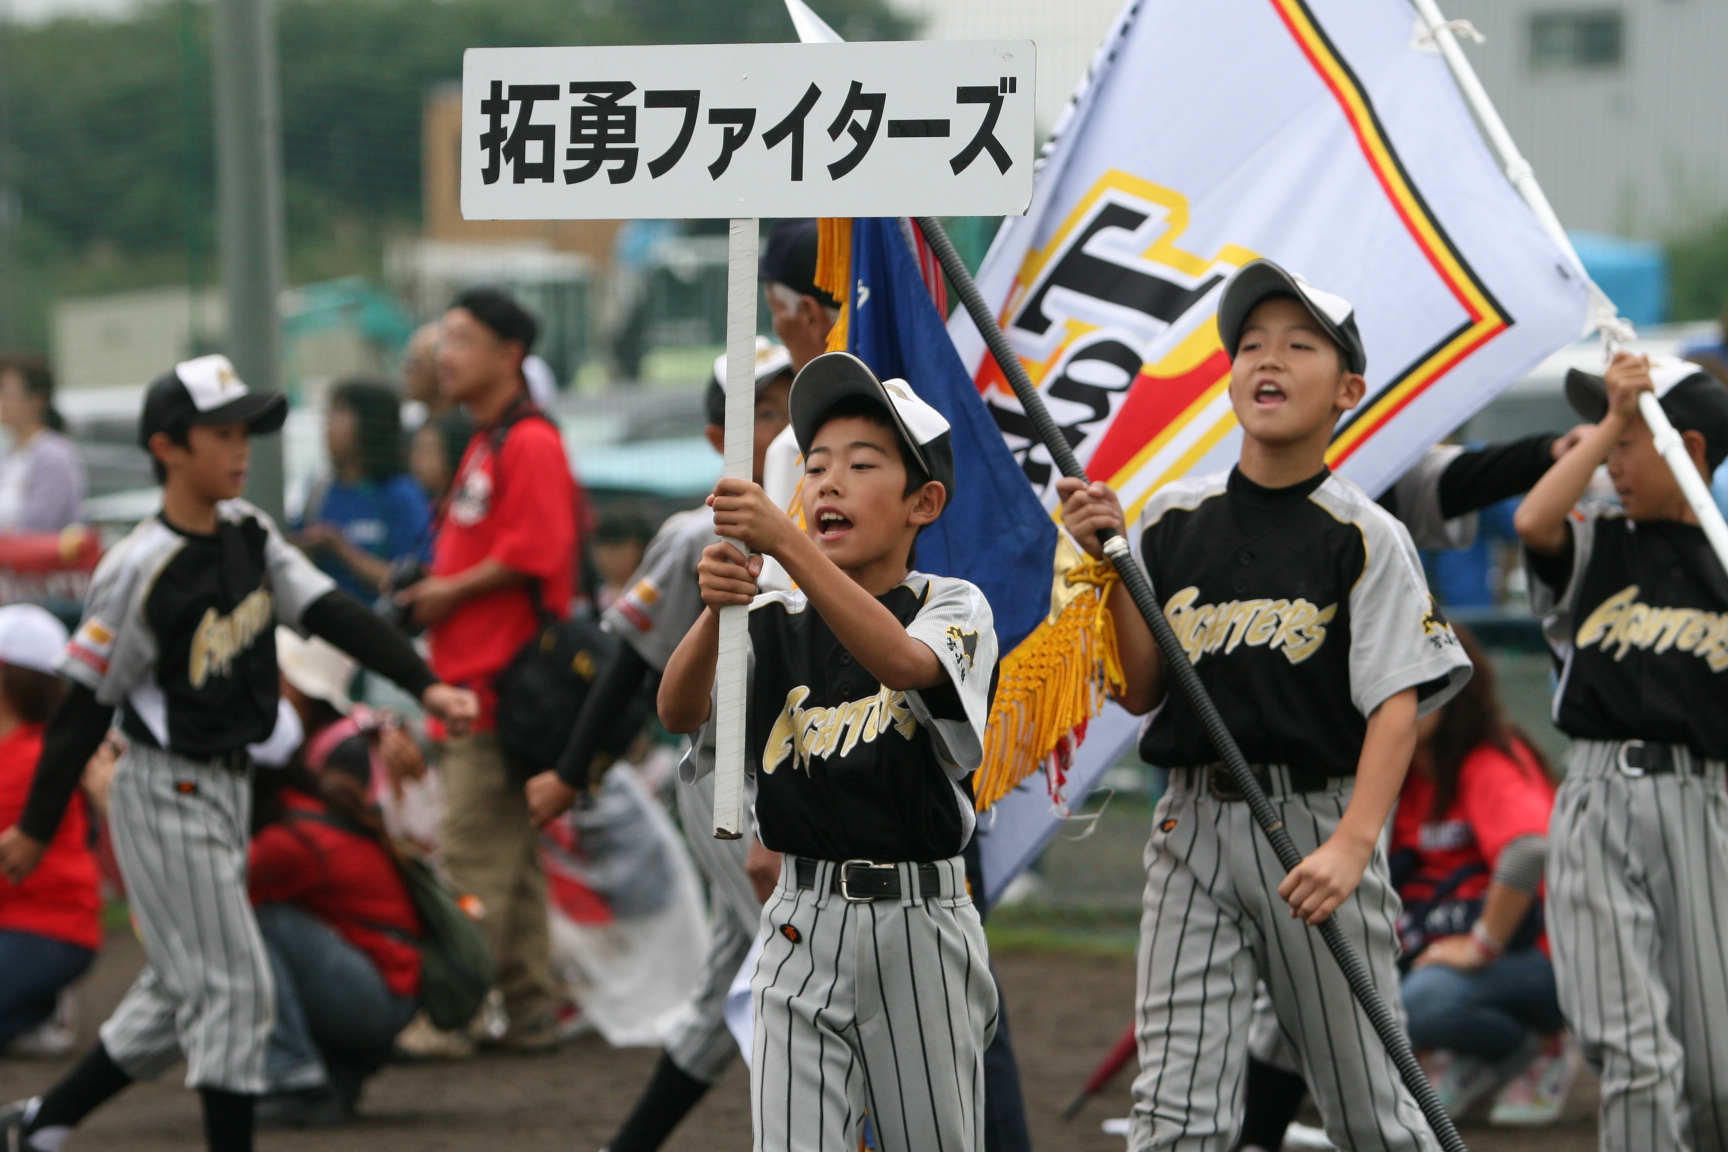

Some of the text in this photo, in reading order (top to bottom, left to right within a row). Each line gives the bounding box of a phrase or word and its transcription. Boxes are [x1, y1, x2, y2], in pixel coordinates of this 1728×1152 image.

[479, 76, 1017, 186] 拓勇ファイターズ
[762, 683, 918, 779] FIGHTR
